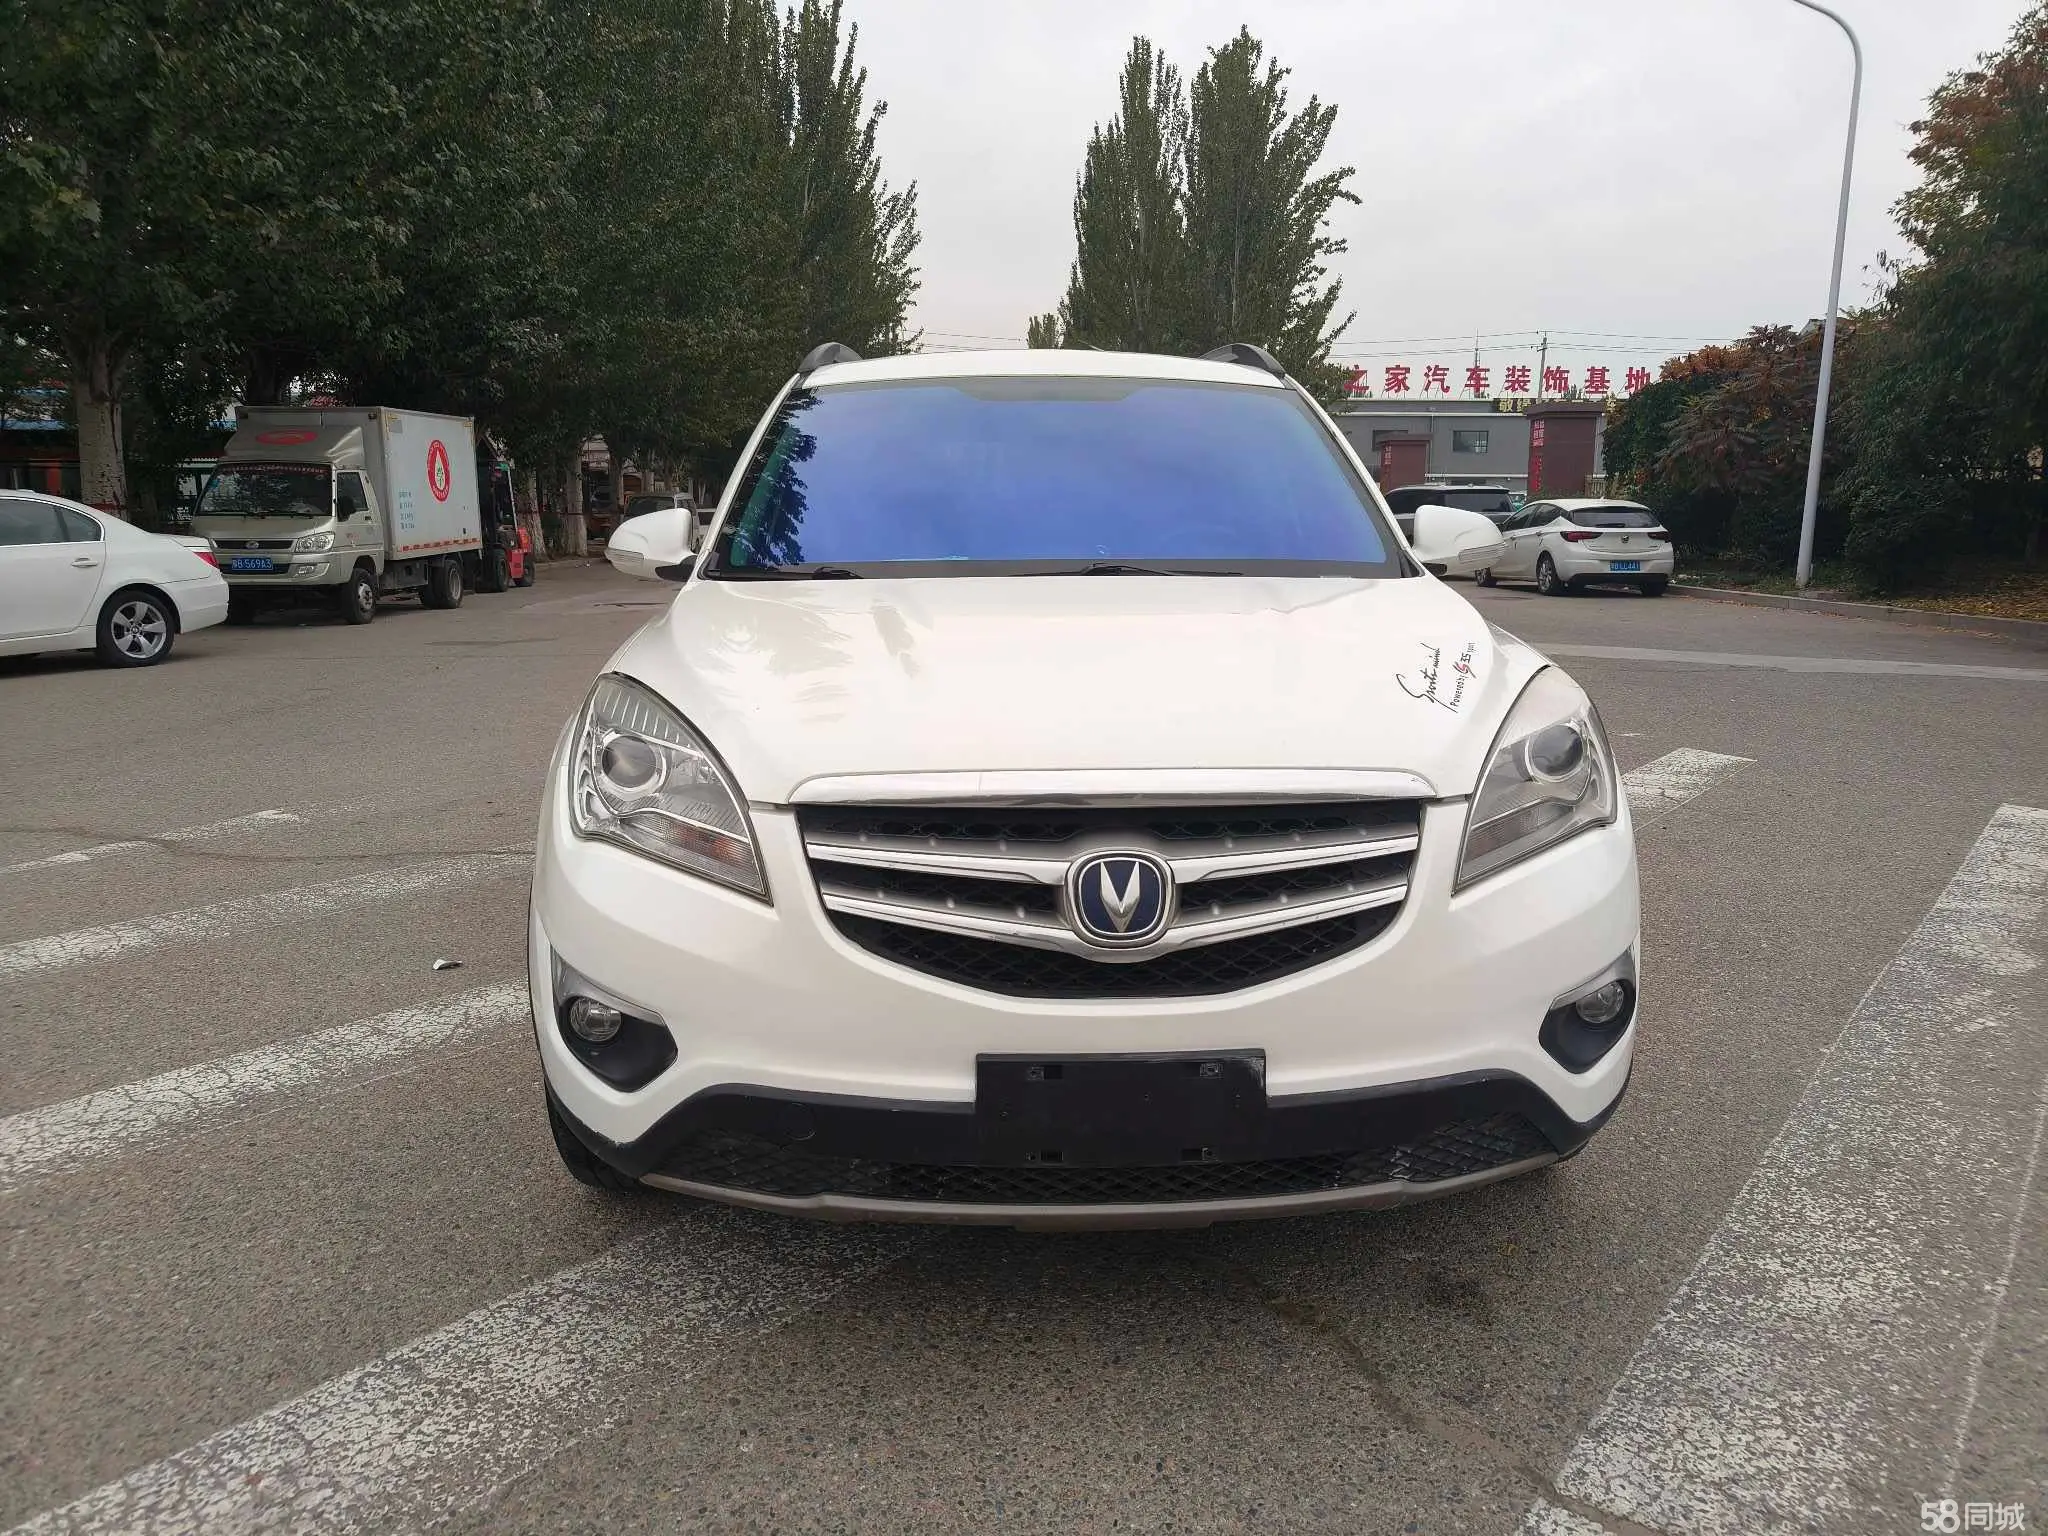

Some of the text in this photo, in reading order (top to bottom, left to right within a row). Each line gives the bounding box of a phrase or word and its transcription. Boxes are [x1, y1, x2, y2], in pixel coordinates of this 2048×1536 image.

[1343, 364, 1650, 394] 之家汽车装饰基地
